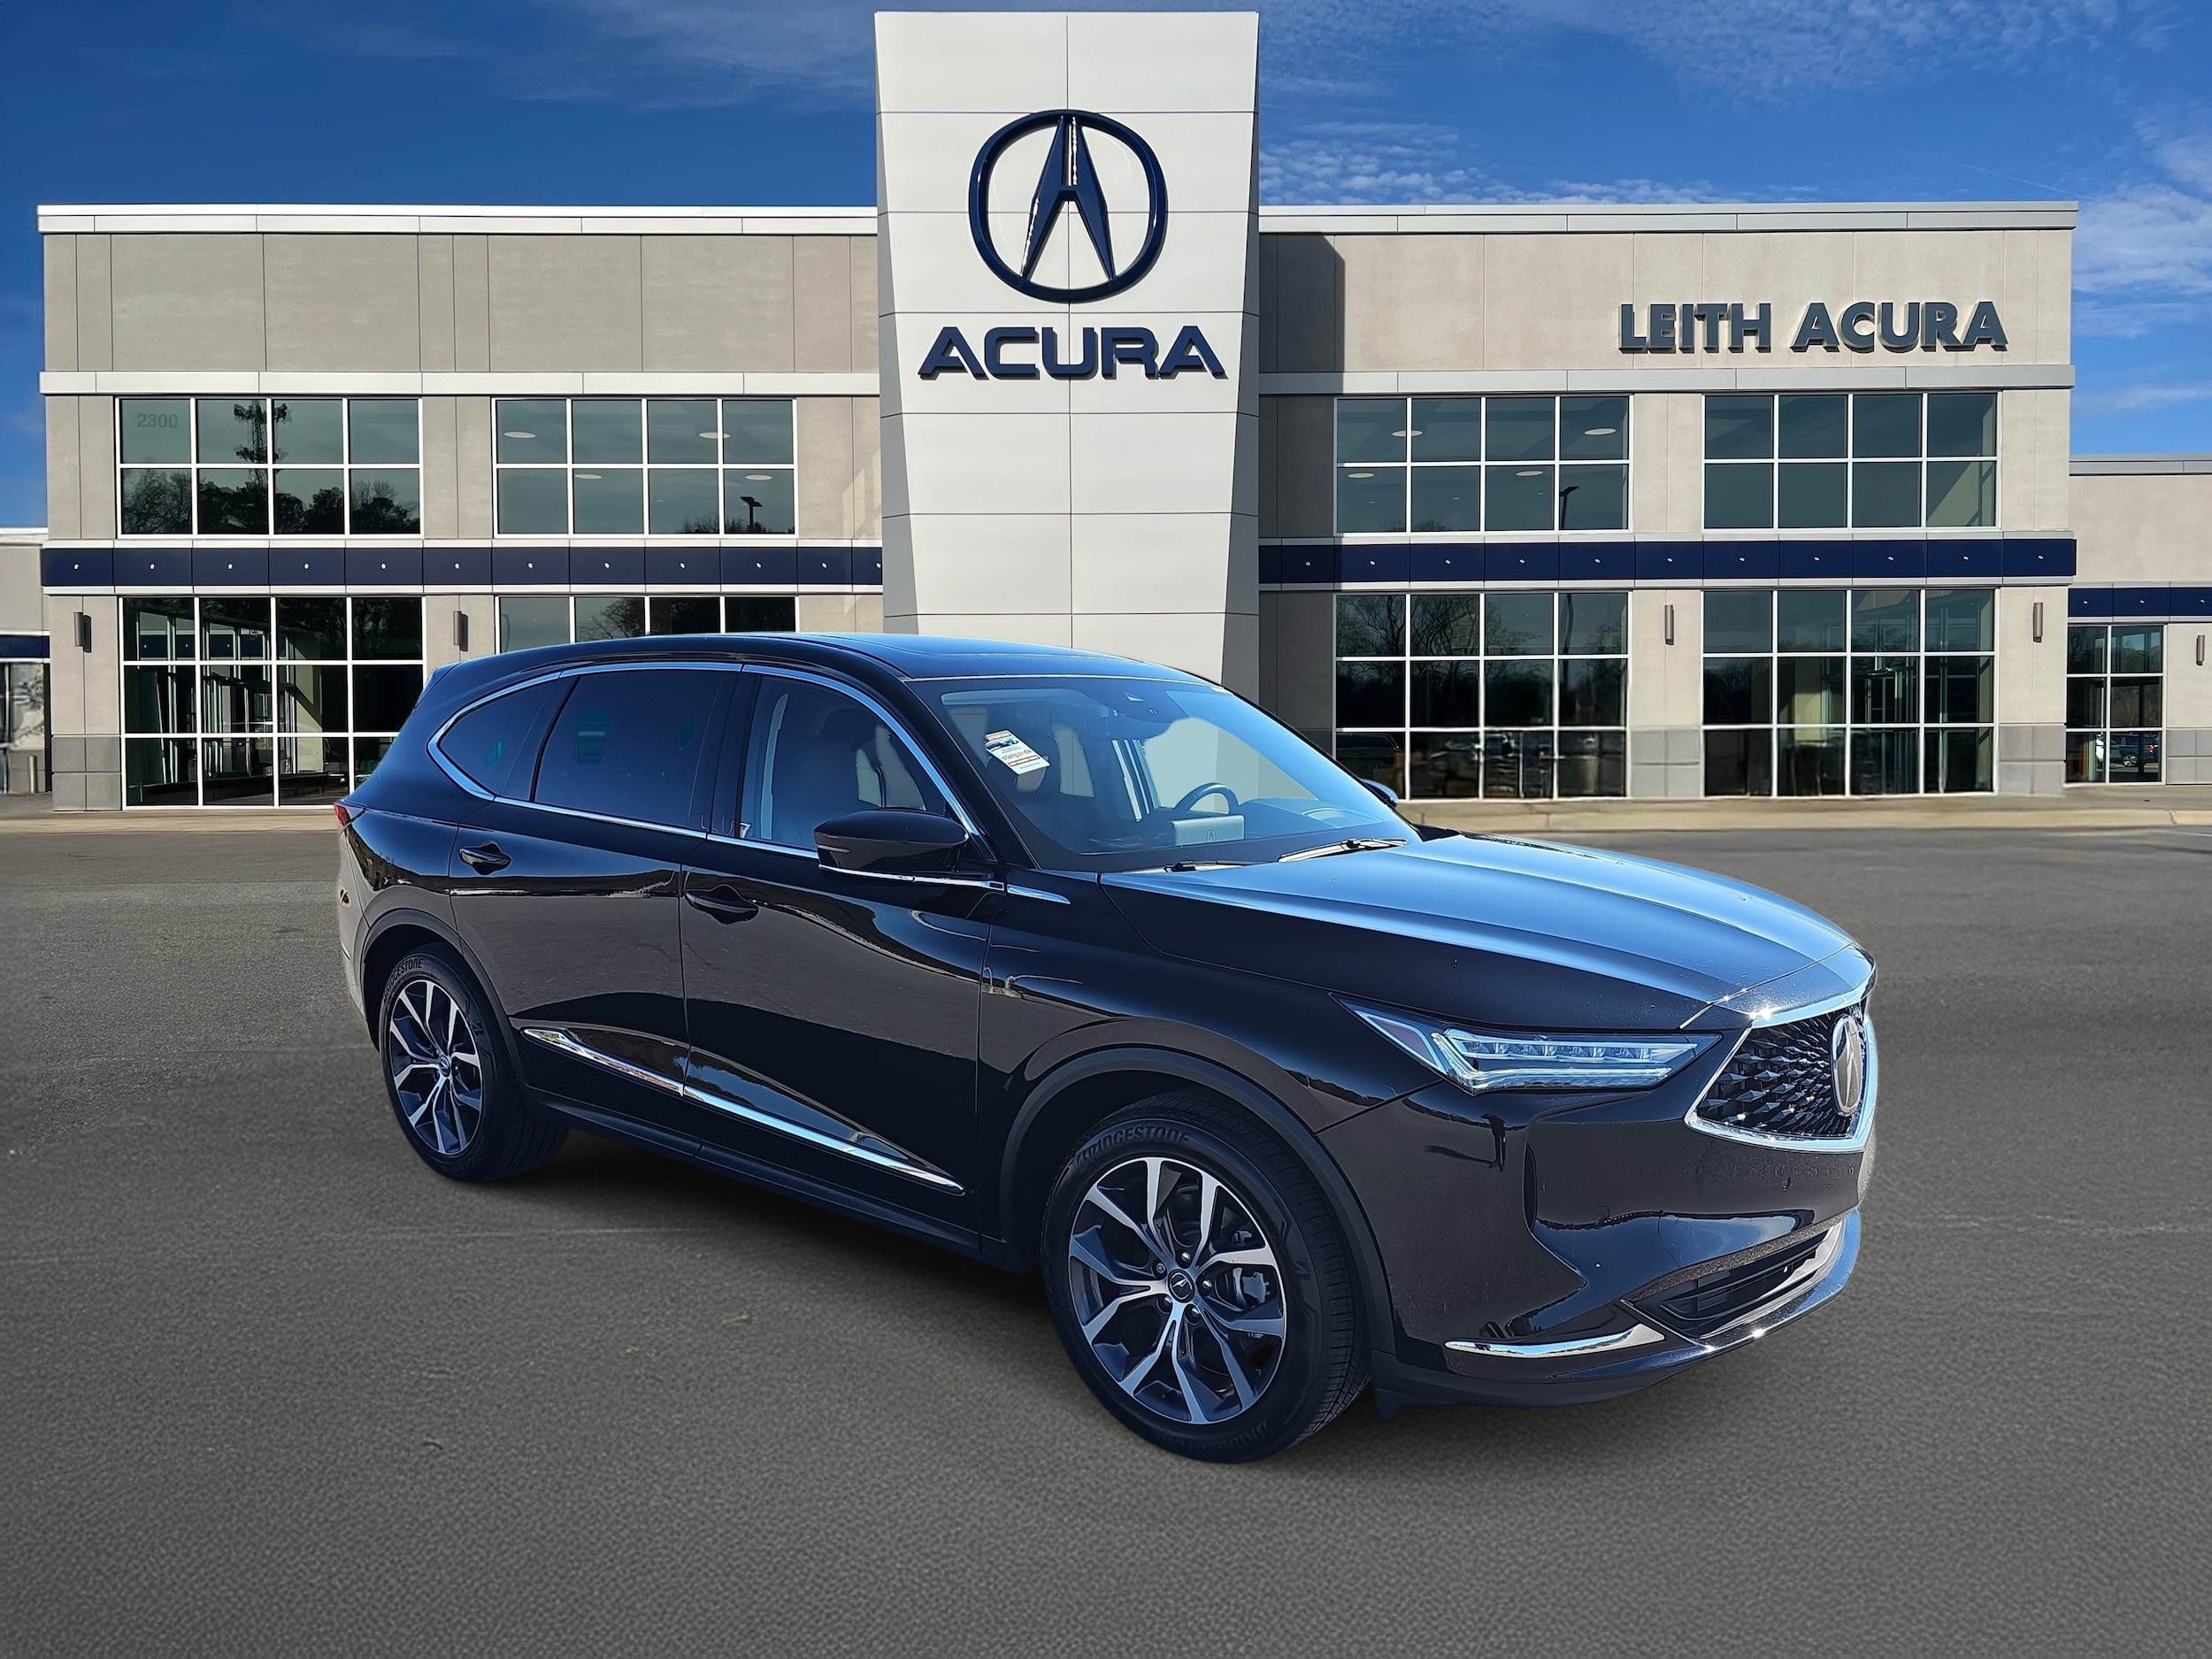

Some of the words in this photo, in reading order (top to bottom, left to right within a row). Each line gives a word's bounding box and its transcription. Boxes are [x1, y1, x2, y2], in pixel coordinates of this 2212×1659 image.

[918, 326, 1228, 379] ACURA
[1618, 302, 1771, 353] LEITH
[1790, 301, 2008, 353] ACURA
[137, 413, 178, 428] 2300
